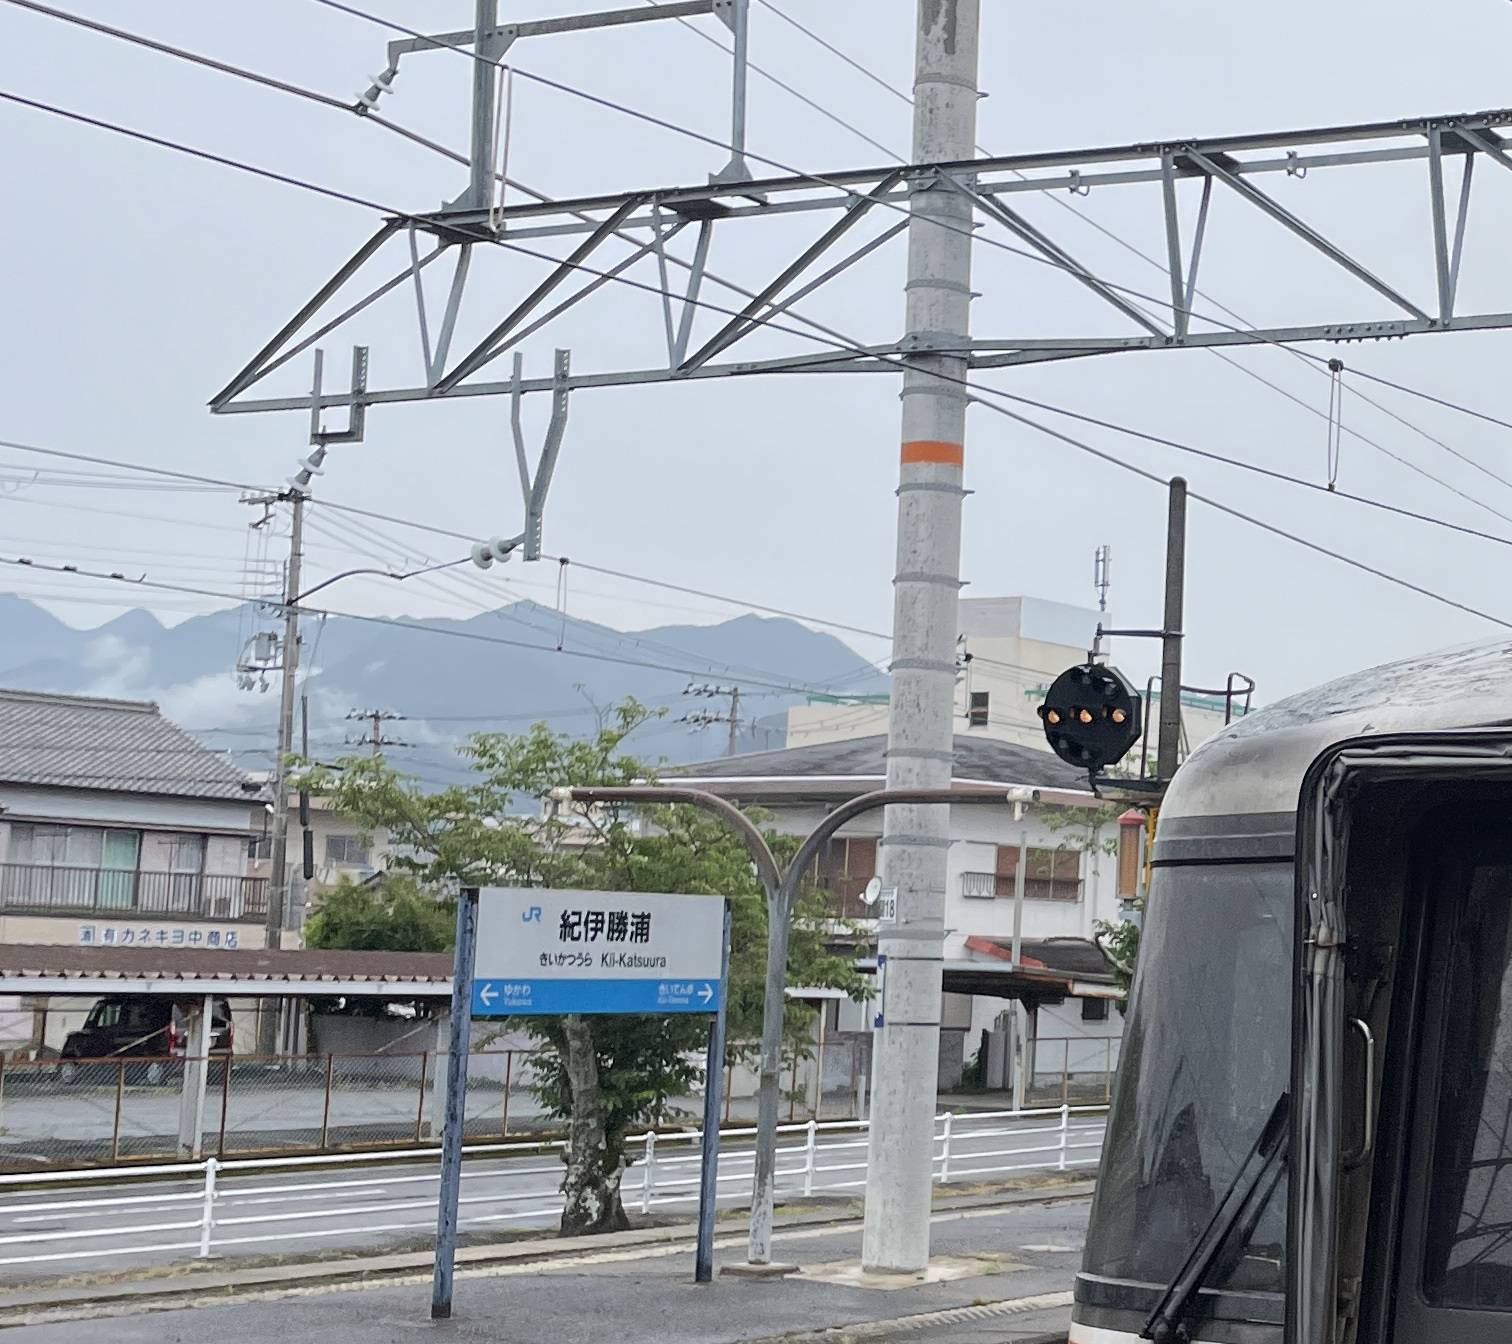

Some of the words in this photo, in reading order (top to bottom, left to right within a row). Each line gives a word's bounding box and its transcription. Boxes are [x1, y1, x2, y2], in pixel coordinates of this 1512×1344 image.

[522, 906, 542, 923] JR
[559, 909, 652, 943] 紀伊勝浦
[539, 952, 593, 967] きいかつうら
[601, 952, 667, 968] Kii-Katsuura
